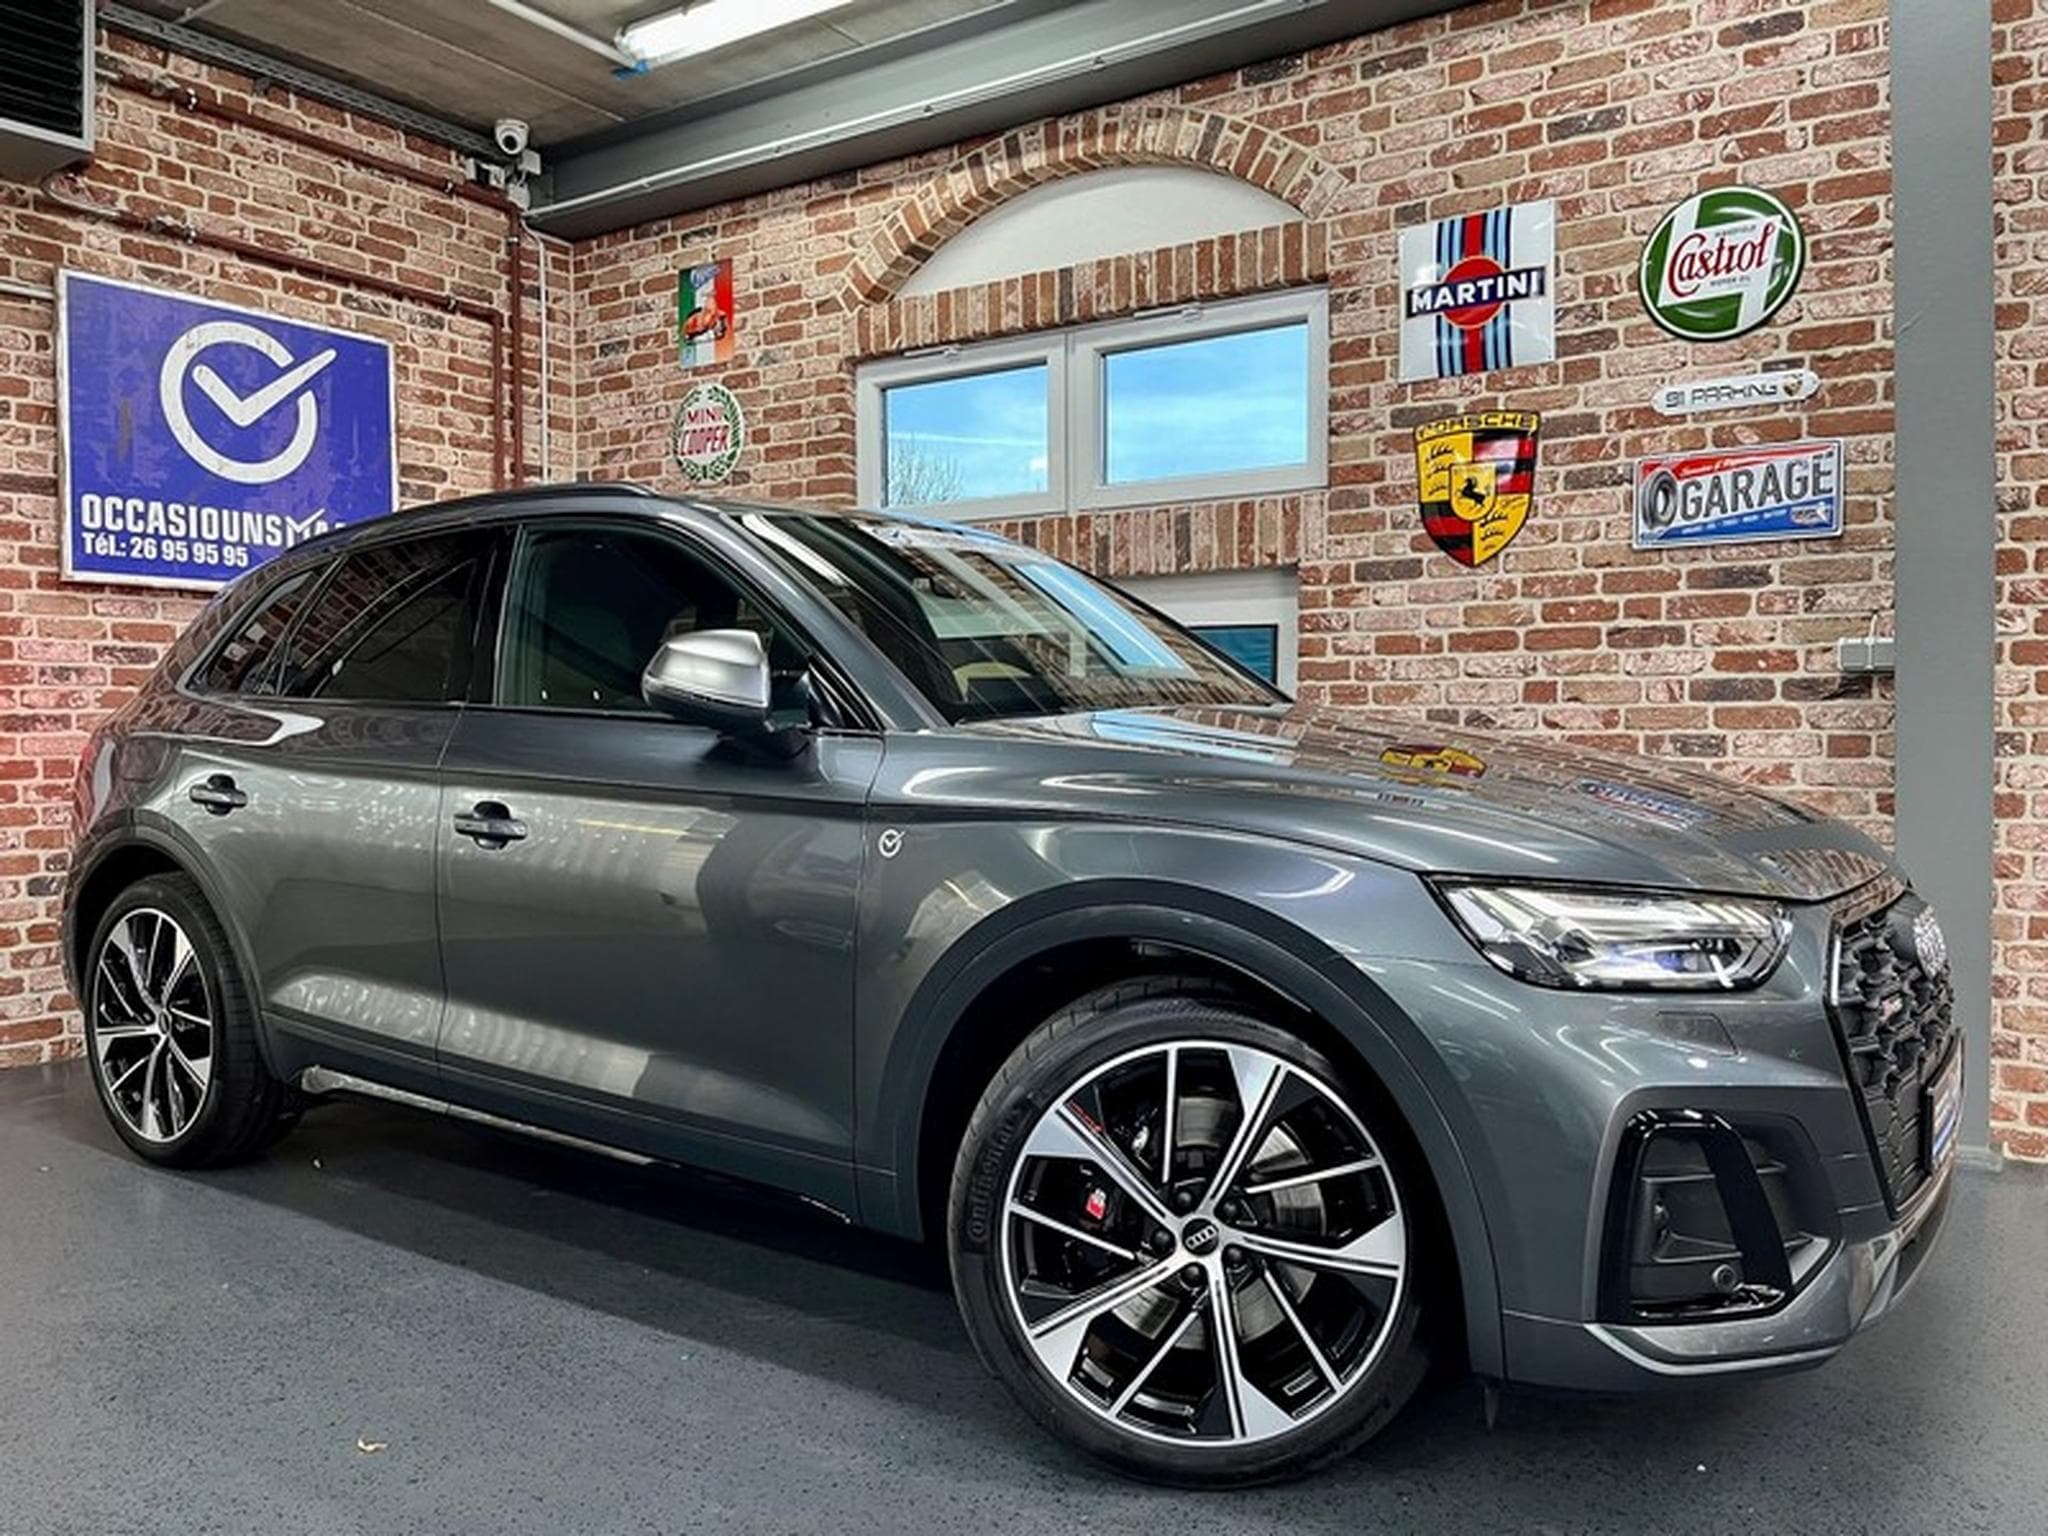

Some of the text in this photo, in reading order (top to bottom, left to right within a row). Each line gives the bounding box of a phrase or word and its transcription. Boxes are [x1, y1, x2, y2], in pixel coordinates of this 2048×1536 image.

[1668, 222, 1776, 298] Castrol
[1411, 271, 1539, 314] MARTINI
[1692, 383, 1778, 402] PARKING
[680, 425, 729, 456] COOPER
[1417, 413, 1537, 440] PORSCHE
[1680, 450, 1834, 522] GARAGE
[130, 537, 158, 560] 26
[161, 540, 188, 563] 95
[192, 543, 219, 565] 95
[223, 546, 249, 567] 95
